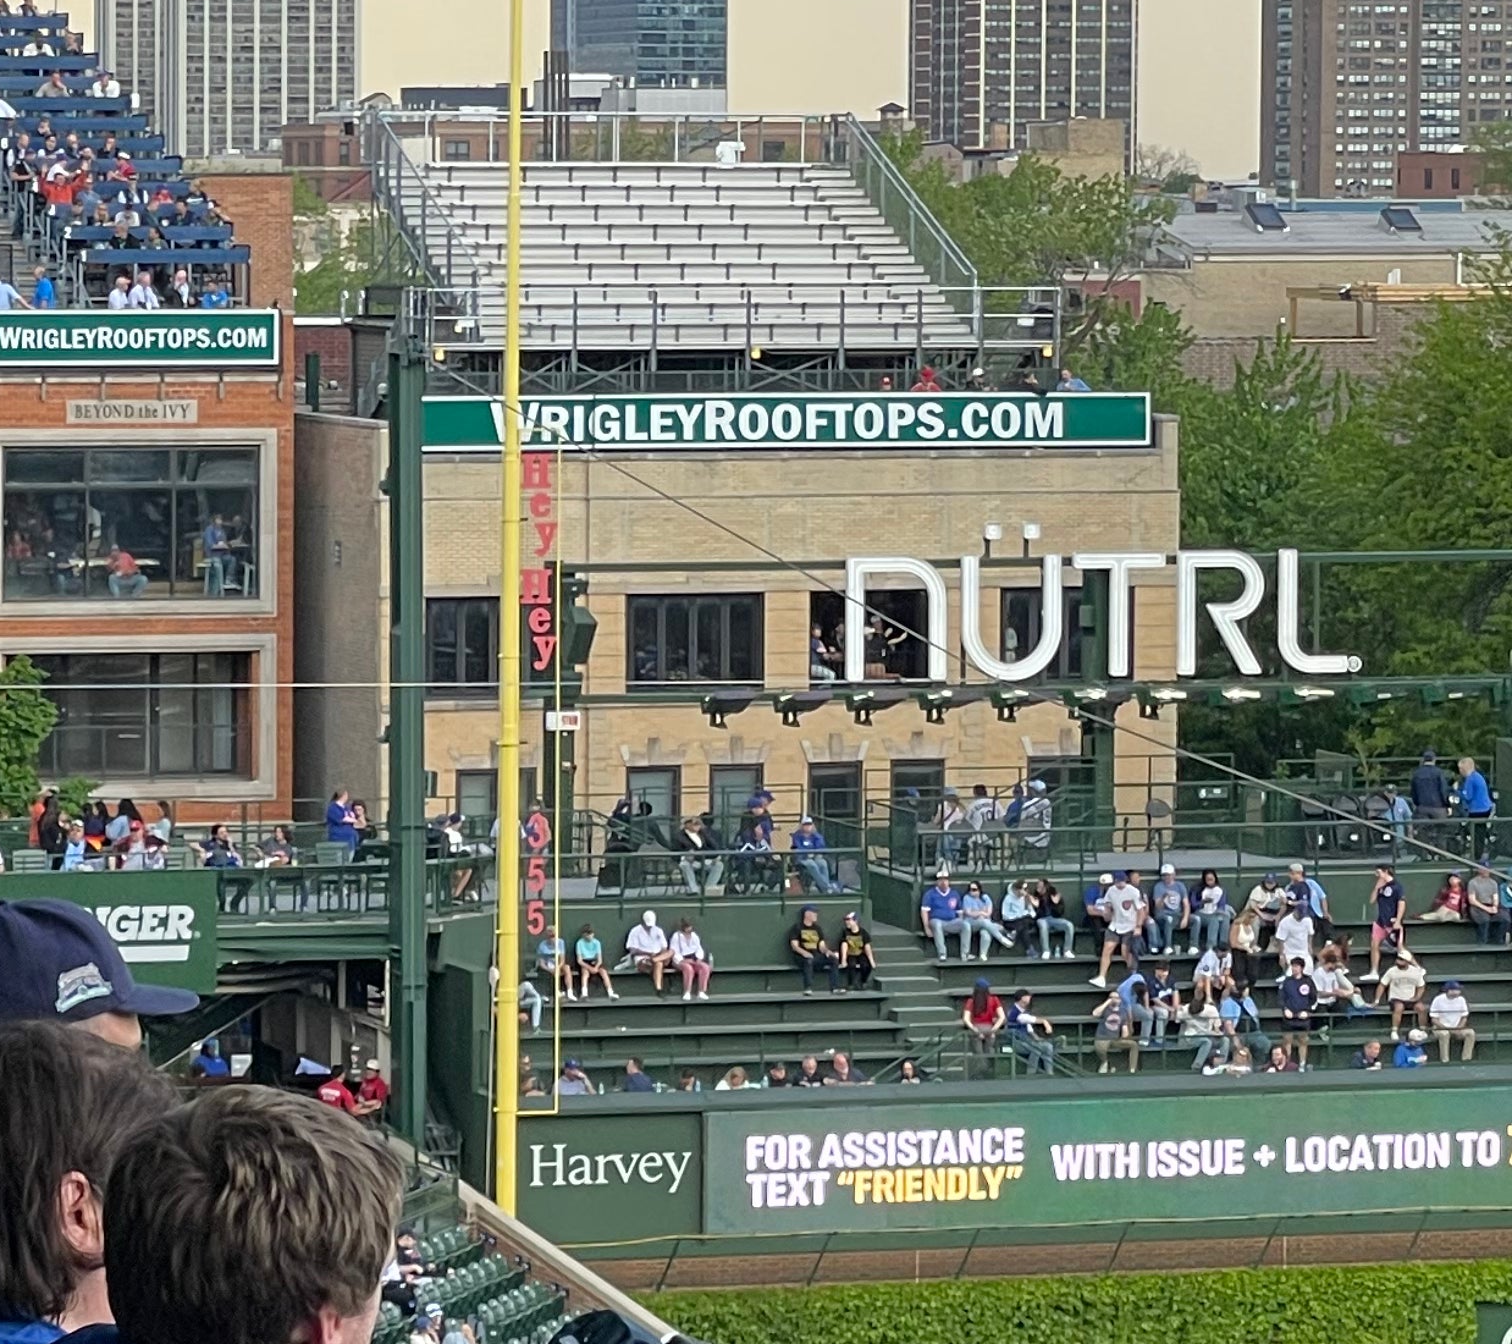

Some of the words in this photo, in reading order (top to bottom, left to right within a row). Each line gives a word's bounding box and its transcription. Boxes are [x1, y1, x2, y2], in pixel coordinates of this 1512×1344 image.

[75, 404, 135, 419] BEYOND
[139, 404, 159, 418] the
[162, 403, 191, 419] IVY
[490, 399, 1062, 443] WRIGLEYROOFTOPS.COM
[520, 453, 558, 556] Hey
[520, 569, 557, 671] Hey
[529, 1144, 692, 1193] Harvey
[745, 1134, 812, 1171] FOR
[819, 1127, 1025, 1169] ASSISTANCE
[1050, 1142, 1141, 1181] WITH
[1147, 1138, 1246, 1178] ISSUE
[1285, 1132, 1451, 1174] LOCATION
[1455, 1130, 1501, 1168] TO
[745, 1172, 829, 1208] TEXT
